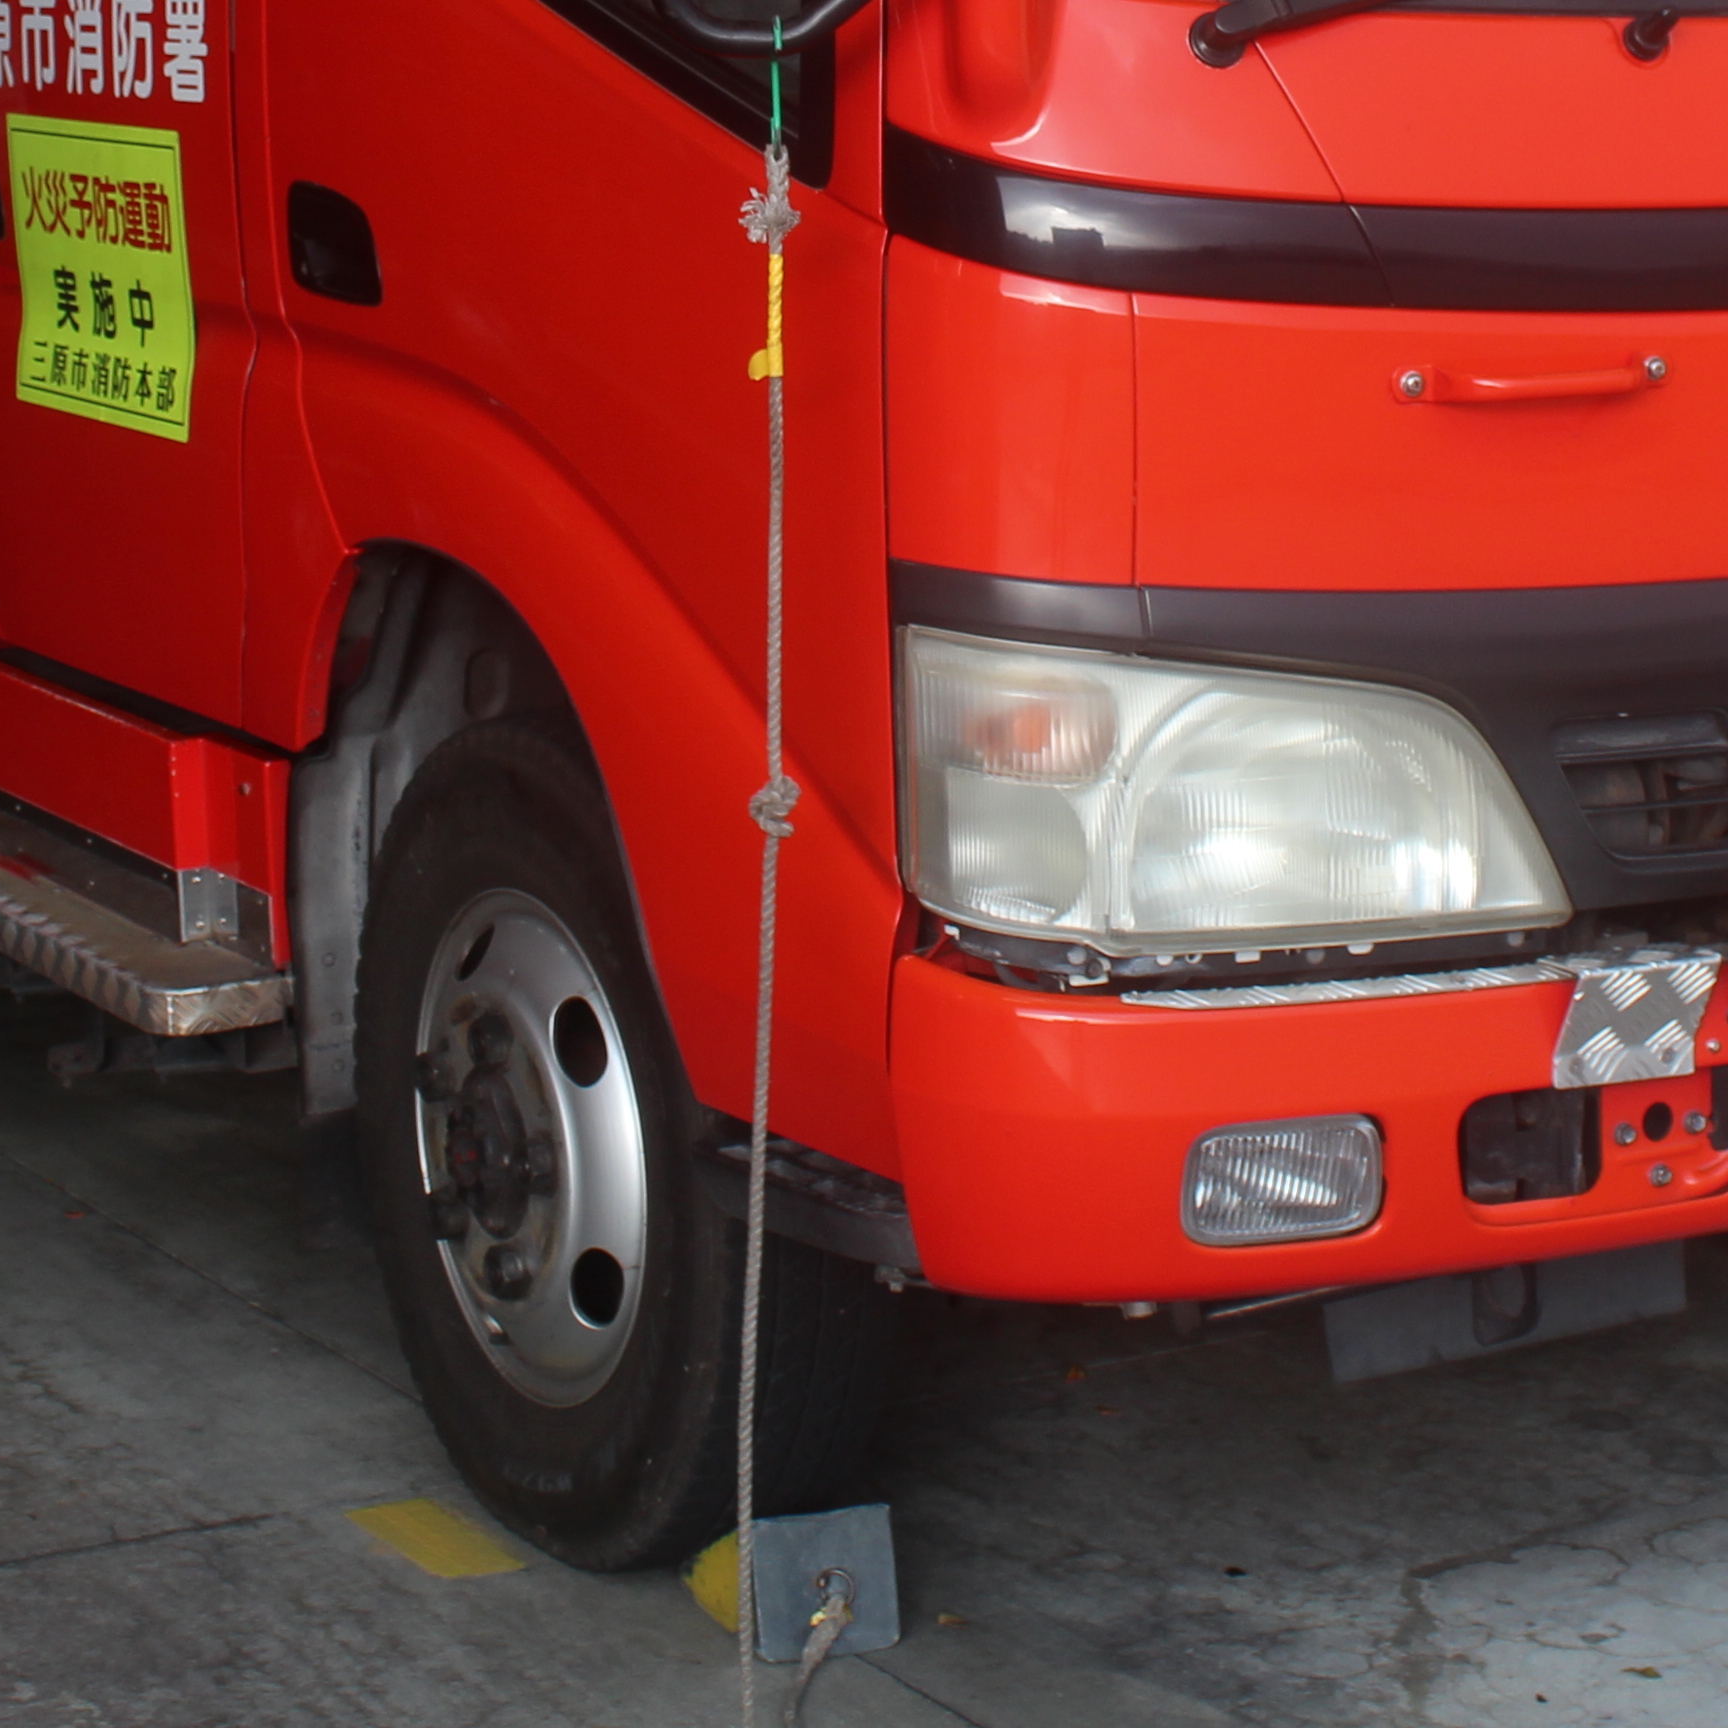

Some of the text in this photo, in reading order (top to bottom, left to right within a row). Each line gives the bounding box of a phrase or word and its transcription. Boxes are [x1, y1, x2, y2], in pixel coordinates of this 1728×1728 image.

[20, 165, 172, 254] 火災予防運動
[53, 264, 155, 349] 実施中
[30, 340, 178, 413] 三原市消防本部
